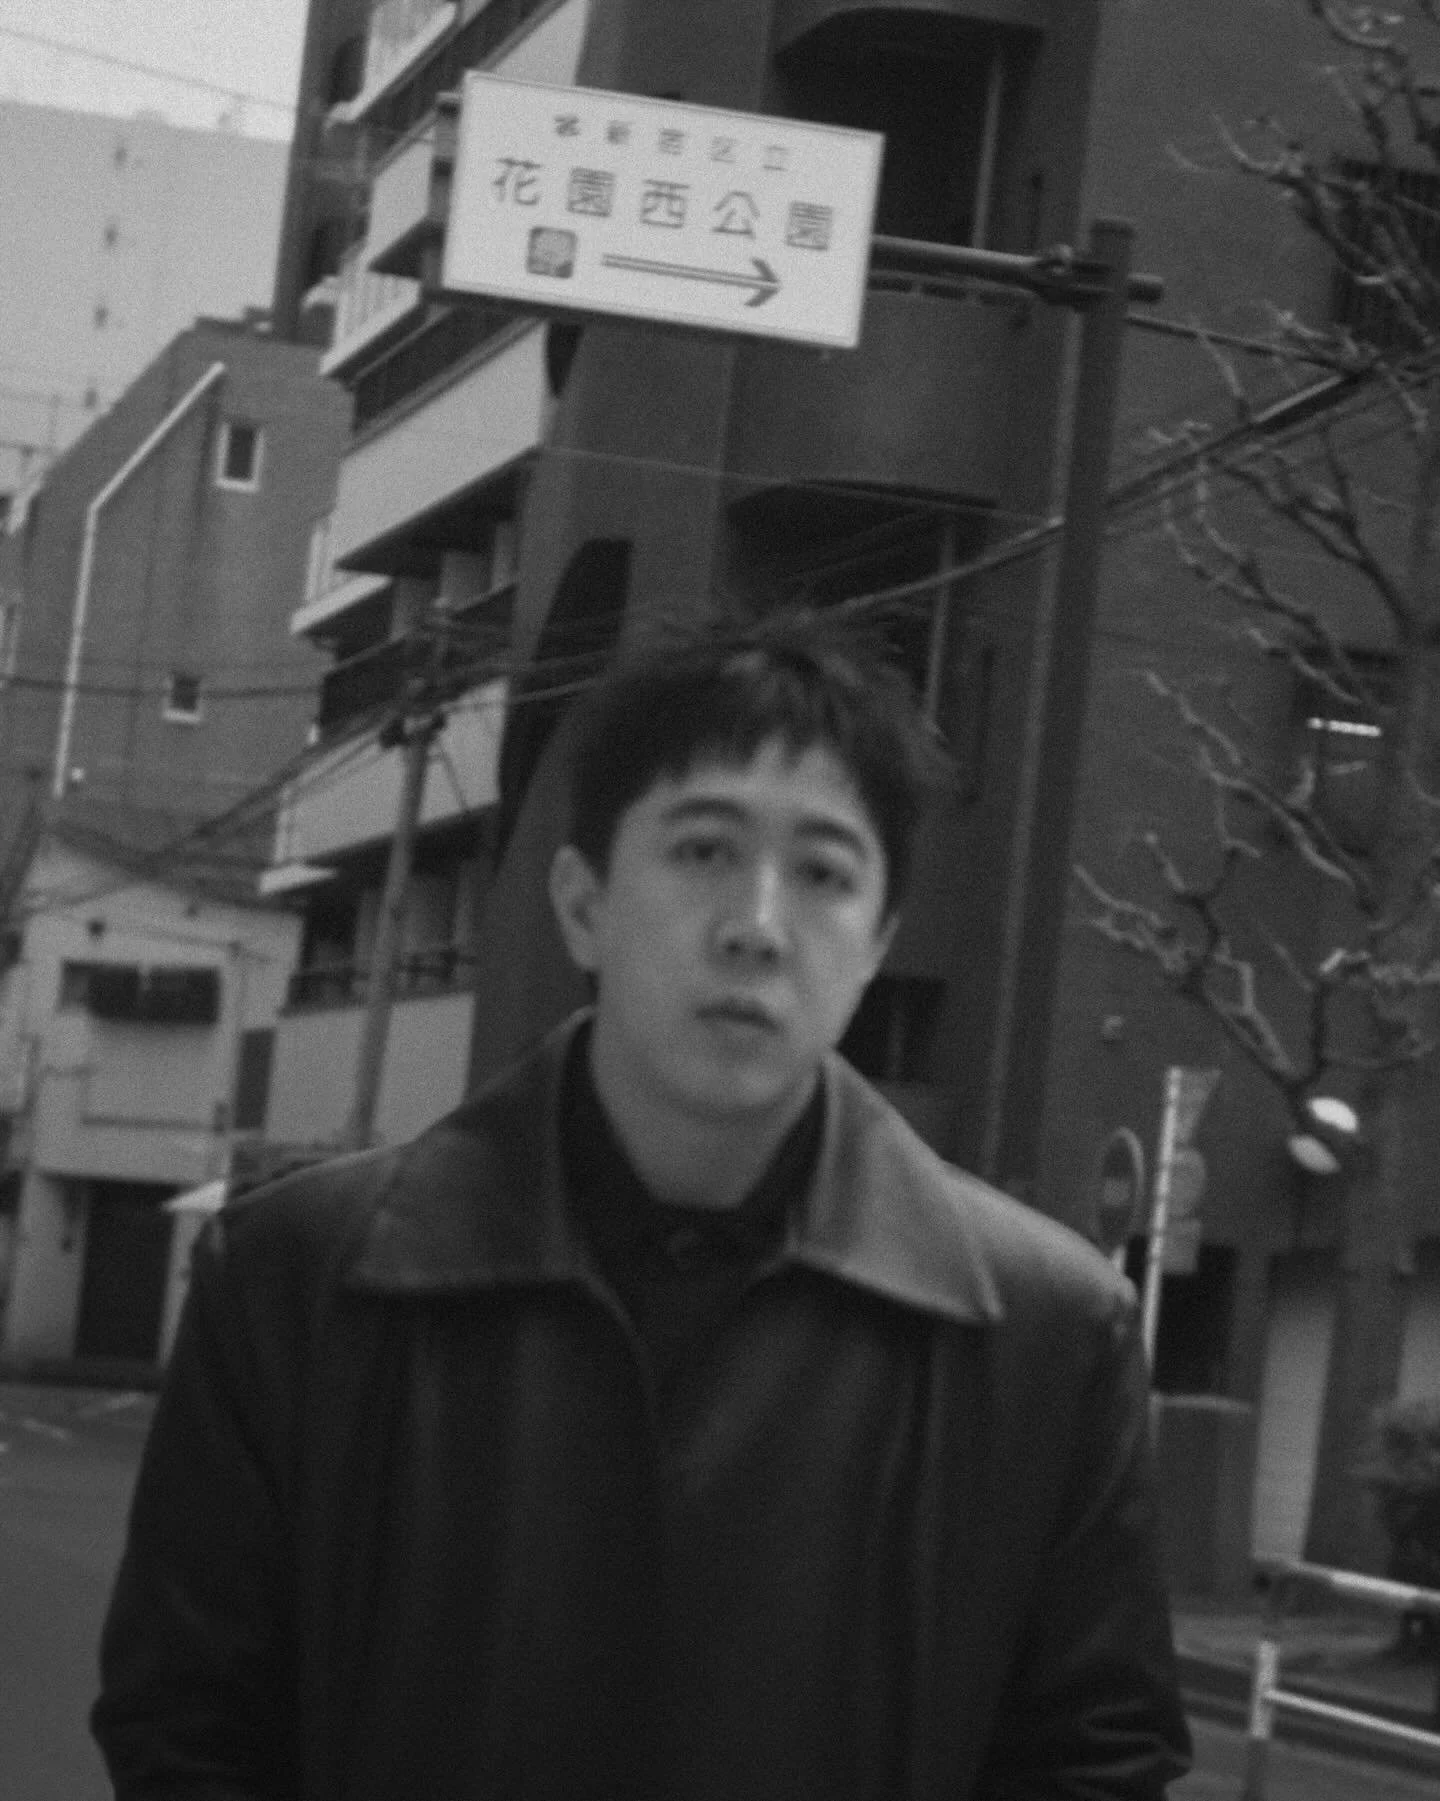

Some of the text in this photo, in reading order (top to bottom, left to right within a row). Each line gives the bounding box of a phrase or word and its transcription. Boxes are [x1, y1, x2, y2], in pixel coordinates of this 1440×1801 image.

[493, 156, 834, 252] 花園西公園
